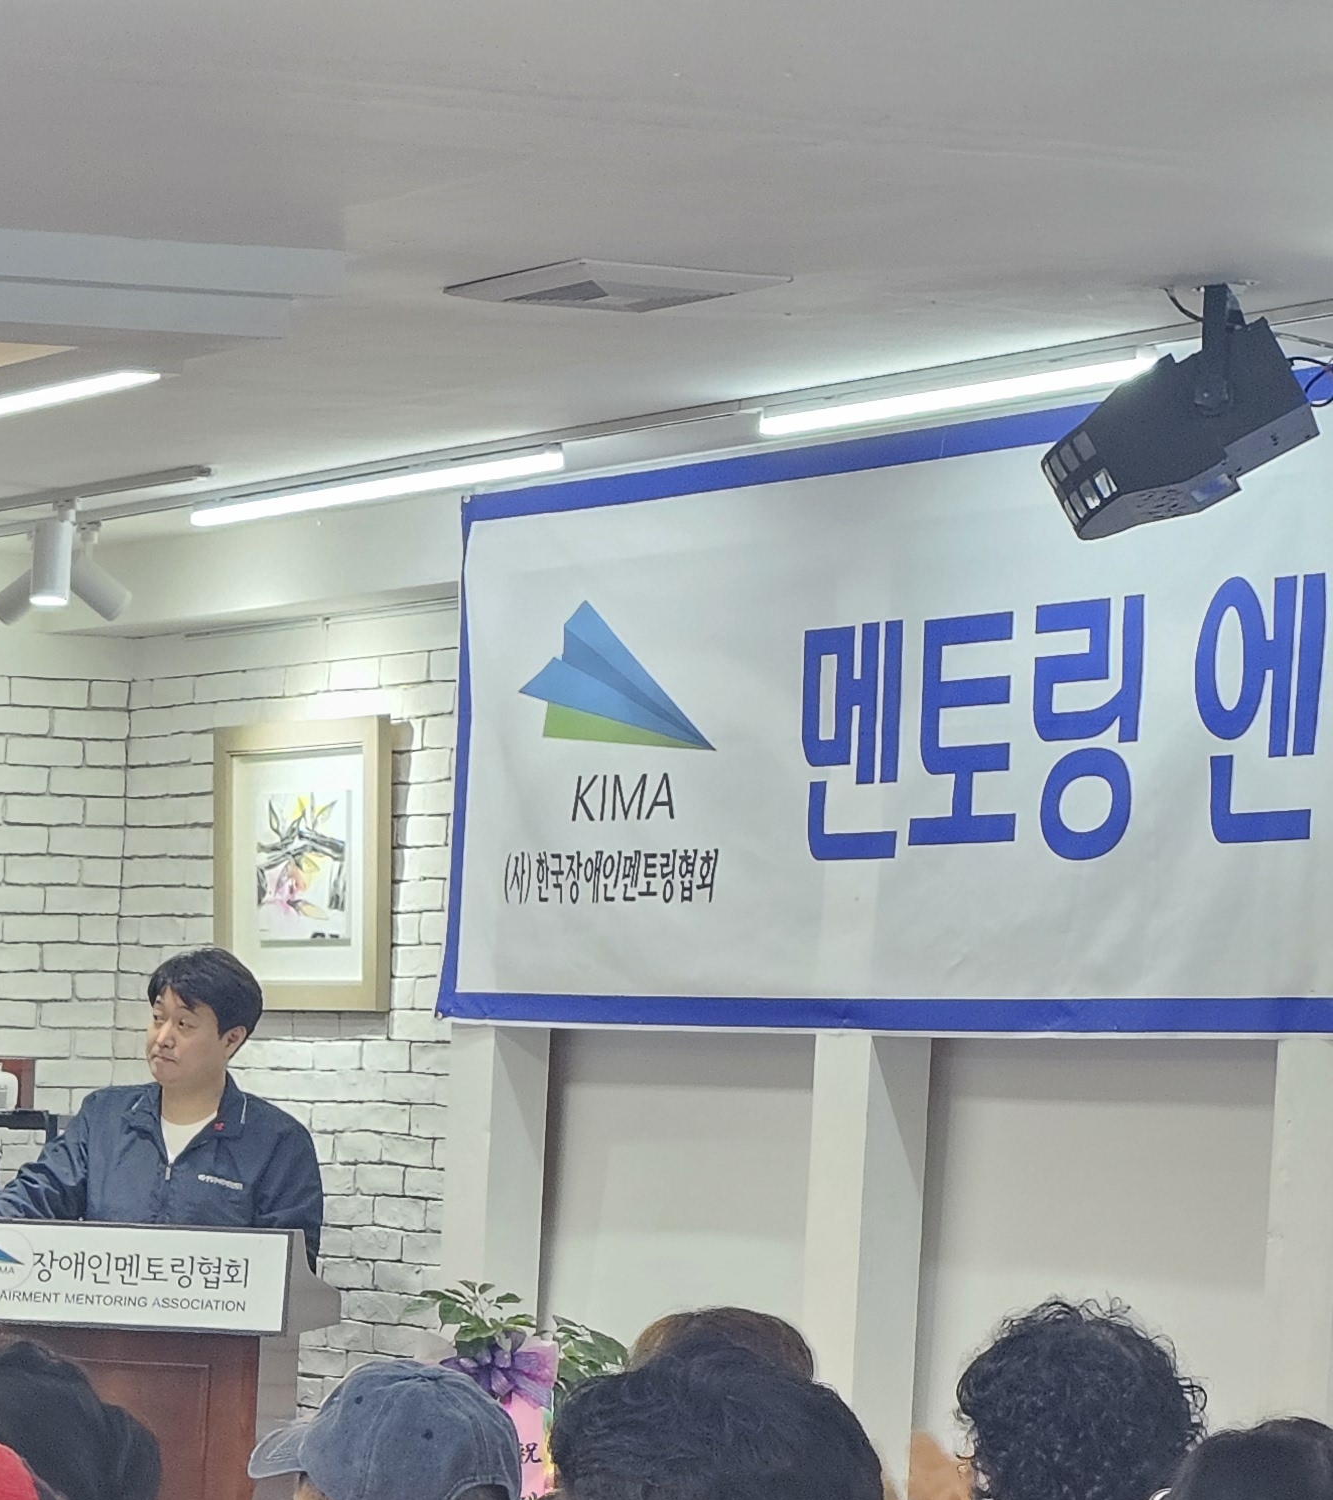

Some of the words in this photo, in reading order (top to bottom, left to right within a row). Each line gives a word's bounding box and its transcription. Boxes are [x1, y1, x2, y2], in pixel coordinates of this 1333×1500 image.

[802, 595, 1145, 861] 멘토링
[1195, 572, 1327, 845] 엔
[571, 772, 675, 822] KIMA
[504, 851, 532, 904] (사)
[536, 848, 720, 904] 한국장애인멘토링협회
[32, 1250, 250, 1289] 장애인멘토링협회
[64, 1293, 148, 1308] MENTORING
[152, 1297, 247, 1312] ASSOCIATION
